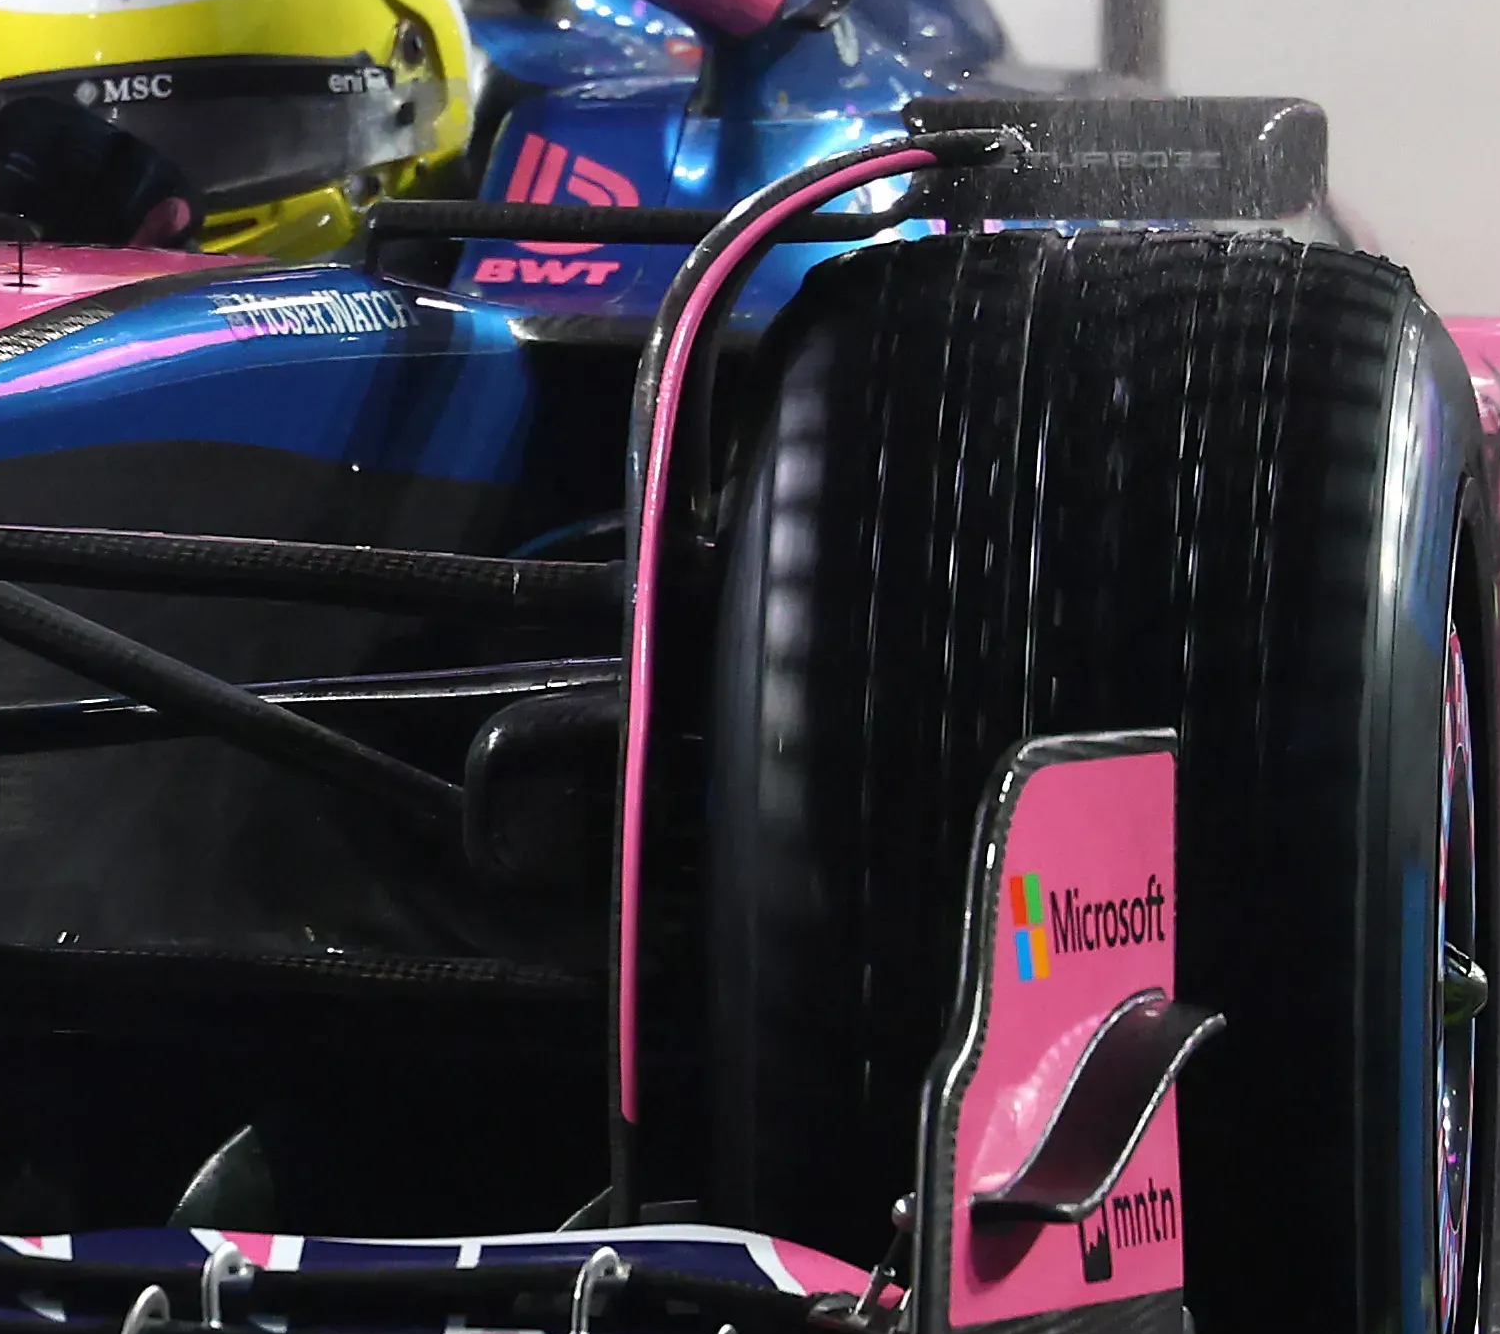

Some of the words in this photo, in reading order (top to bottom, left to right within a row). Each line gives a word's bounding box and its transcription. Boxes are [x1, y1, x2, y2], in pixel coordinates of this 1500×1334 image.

[103, 74, 173, 104] MSC
[327, 69, 364, 94] eni
[473, 257, 621, 286] BWT
[1050, 874, 1166, 954] Microsoft
[1112, 1177, 1176, 1249] mntn
